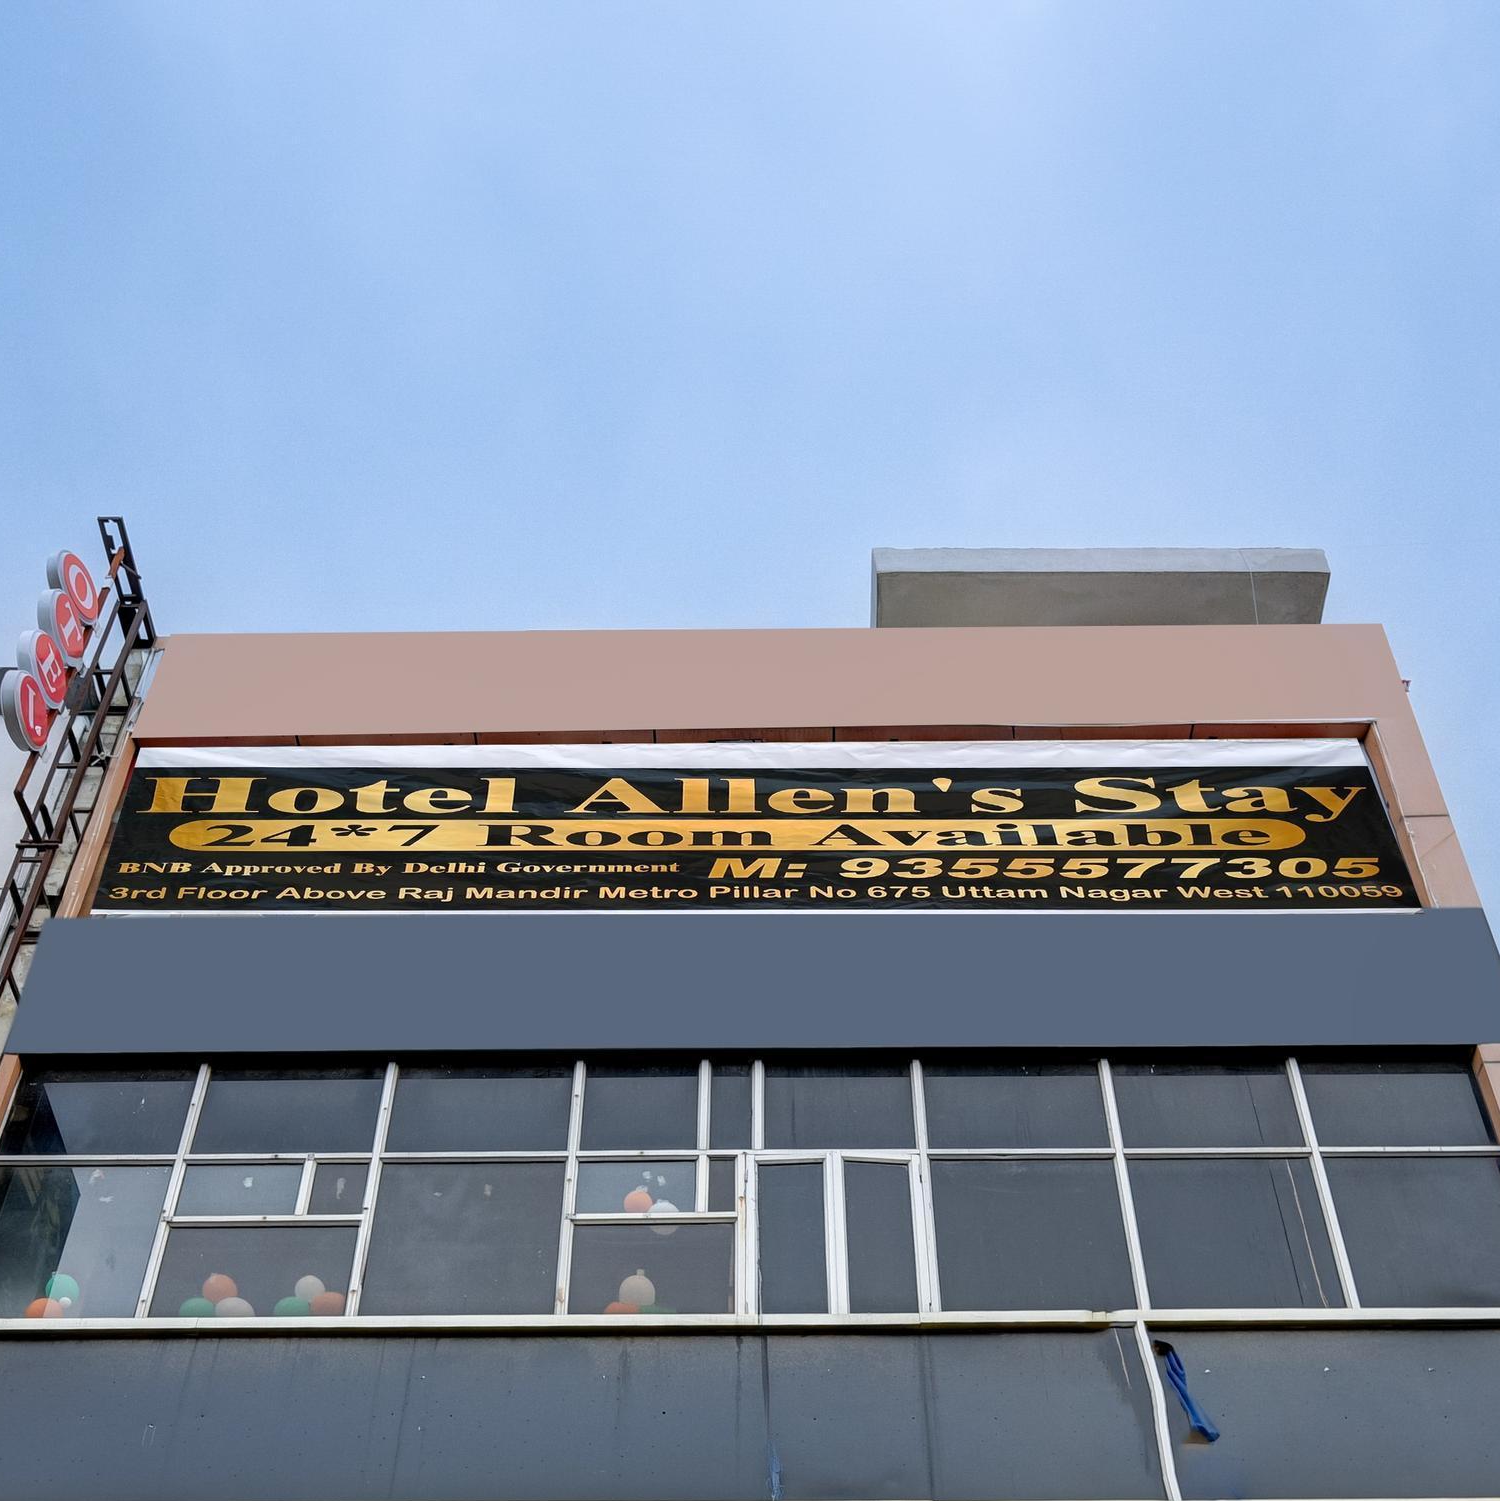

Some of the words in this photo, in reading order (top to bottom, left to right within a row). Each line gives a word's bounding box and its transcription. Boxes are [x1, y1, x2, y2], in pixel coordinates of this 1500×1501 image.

[136, 777, 520, 814] Hotel
[564, 777, 1023, 814] Allen's
[1075, 776, 1367, 822] Stay
[476, 823, 772, 848] Room
[810, 823, 1273, 847] Available
[118, 862, 192, 875] BNB
[201, 862, 341, 877] Approved
[351, 863, 393, 877] By
[403, 862, 486, 875] Delhi
[497, 862, 681, 875] Government
[839, 857, 1381, 879] 9355577305
[108, 886, 167, 900] 3rd
[177, 886, 269, 900] Floor
[276, 886, 387, 900] Above
[398, 886, 455, 903] Raj
[466, 886, 593, 900] Mandir
[599, 886, 699, 900] Metro
[710, 886, 799, 899] Pillar
[810, 886, 857, 899] No
[867, 886, 931, 899] 675
[942, 886, 1048, 899] Uttam
[1060, 886, 1168, 902] Nagar
[1177, 885, 1269, 899] West
[1276, 885, 1403, 899] 110059
